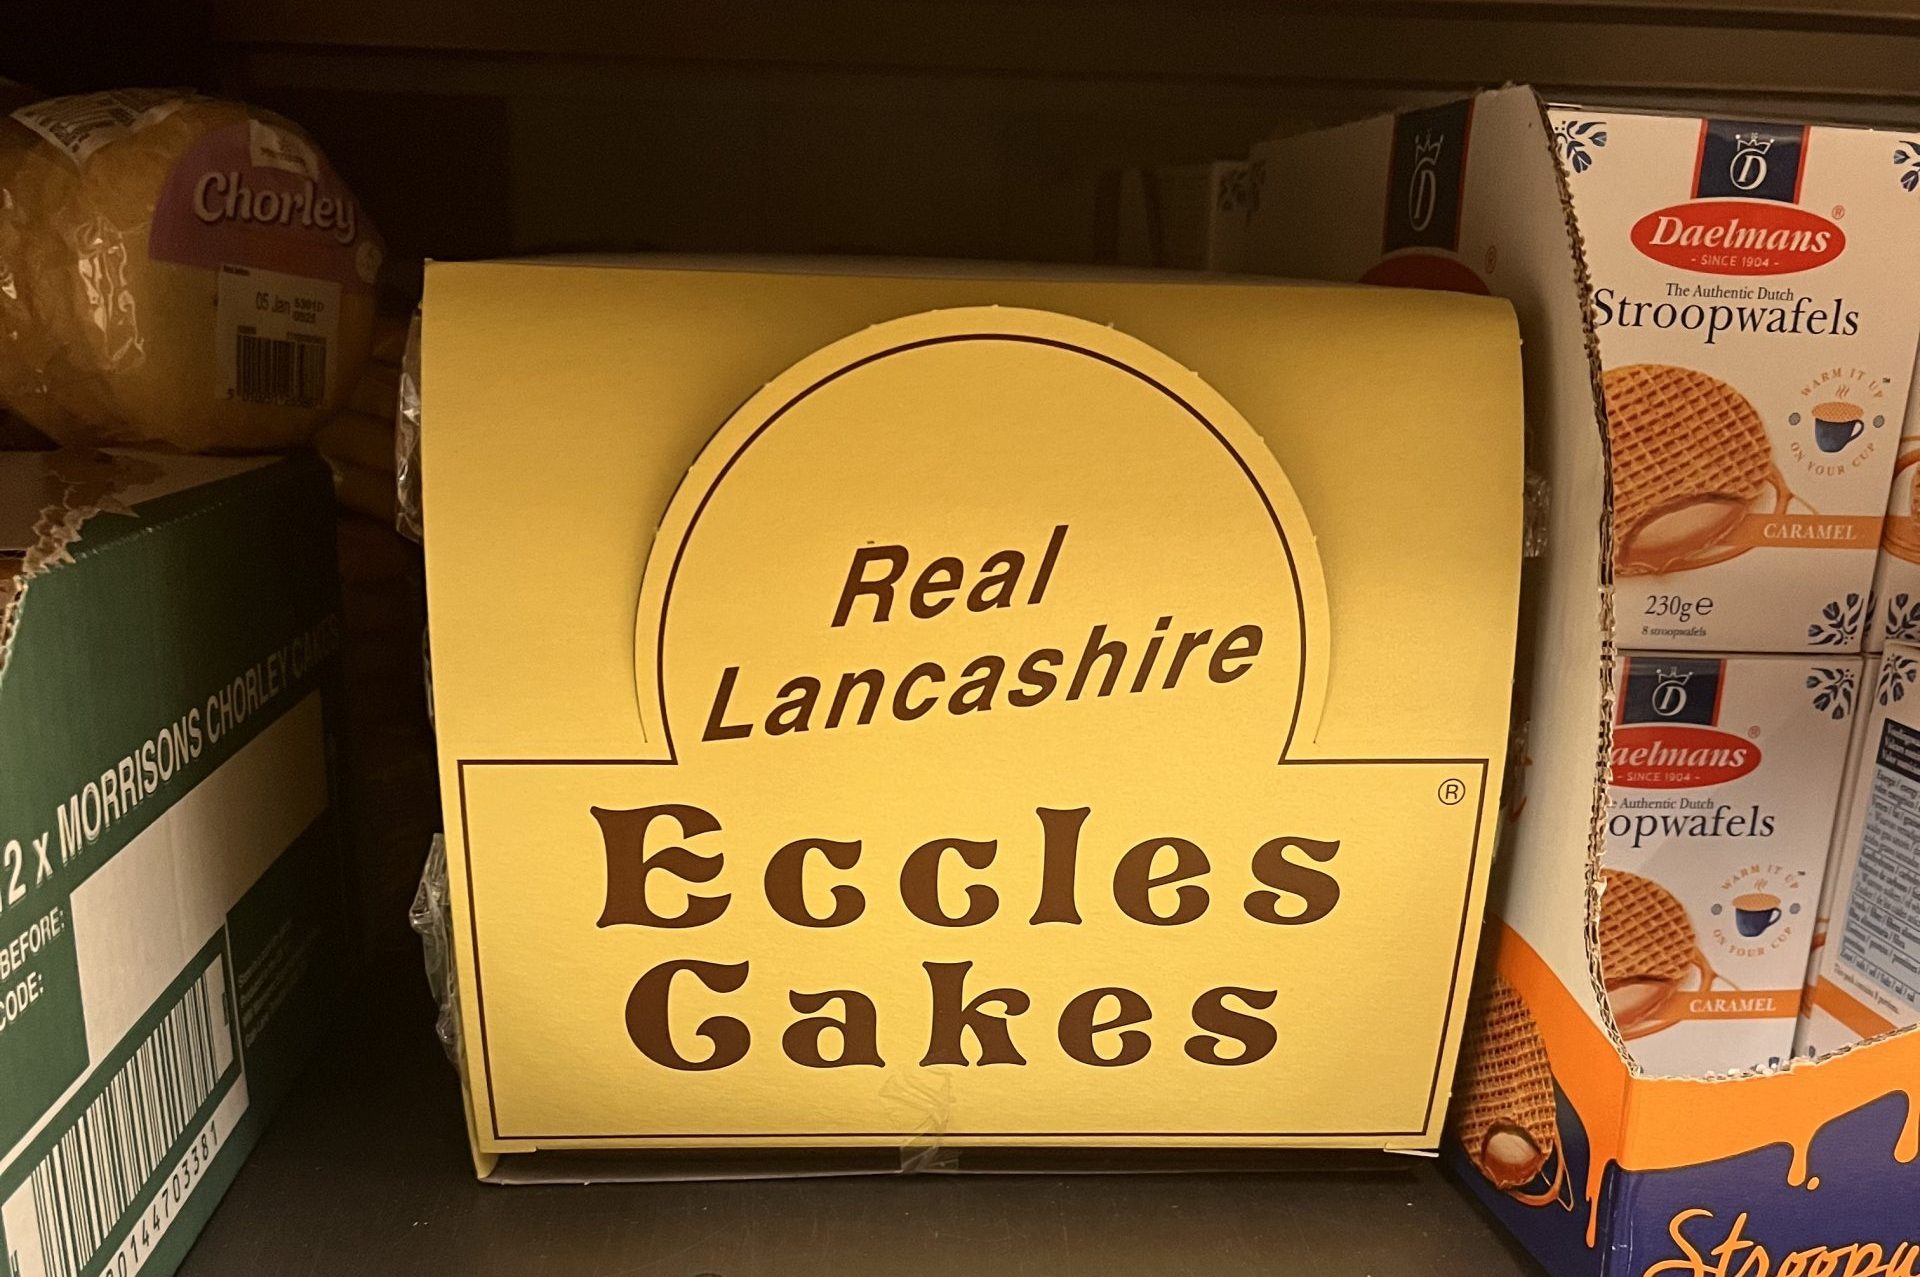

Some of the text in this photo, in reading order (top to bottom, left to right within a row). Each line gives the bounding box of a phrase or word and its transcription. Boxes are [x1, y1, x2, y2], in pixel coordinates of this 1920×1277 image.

[193, 170, 357, 245] Chorley
[1649, 215, 1832, 253] Daelmans
[1700, 254, 1770, 268] SINCE 1904
[1665, 282, 1795, 302] The Authentic Dutch
[1593, 287, 1859, 344] Stroopwafels
[1800, 367, 1883, 398] WARM IT UP
[1790, 441, 1875, 477] ON YOUR CUP
[1763, 522, 1858, 541] CARAMEL
[831, 525, 1069, 628] Real
[1641, 626, 1649, 636] 8
[701, 615, 1264, 742] Lancashire
[1610, 739, 1748, 768] aelmans
[0, 839, 27, 914] 2
[56, 706, 204, 864] MORRISONS
[206, 645, 289, 744] CHORLEY
[1626, 771, 1691, 782] SINCE 1904
[1620, 796, 1677, 809] Authentic
[1680, 797, 1715, 810] Dutch
[1608, 804, 1776, 849] opwafels
[588, 803, 1342, 929] Eccles
[0, 905, 65, 981] BEFORE:
[624, 958, 1278, 1072] Cakes
[1689, 997, 1777, 1013] CARAMEL
